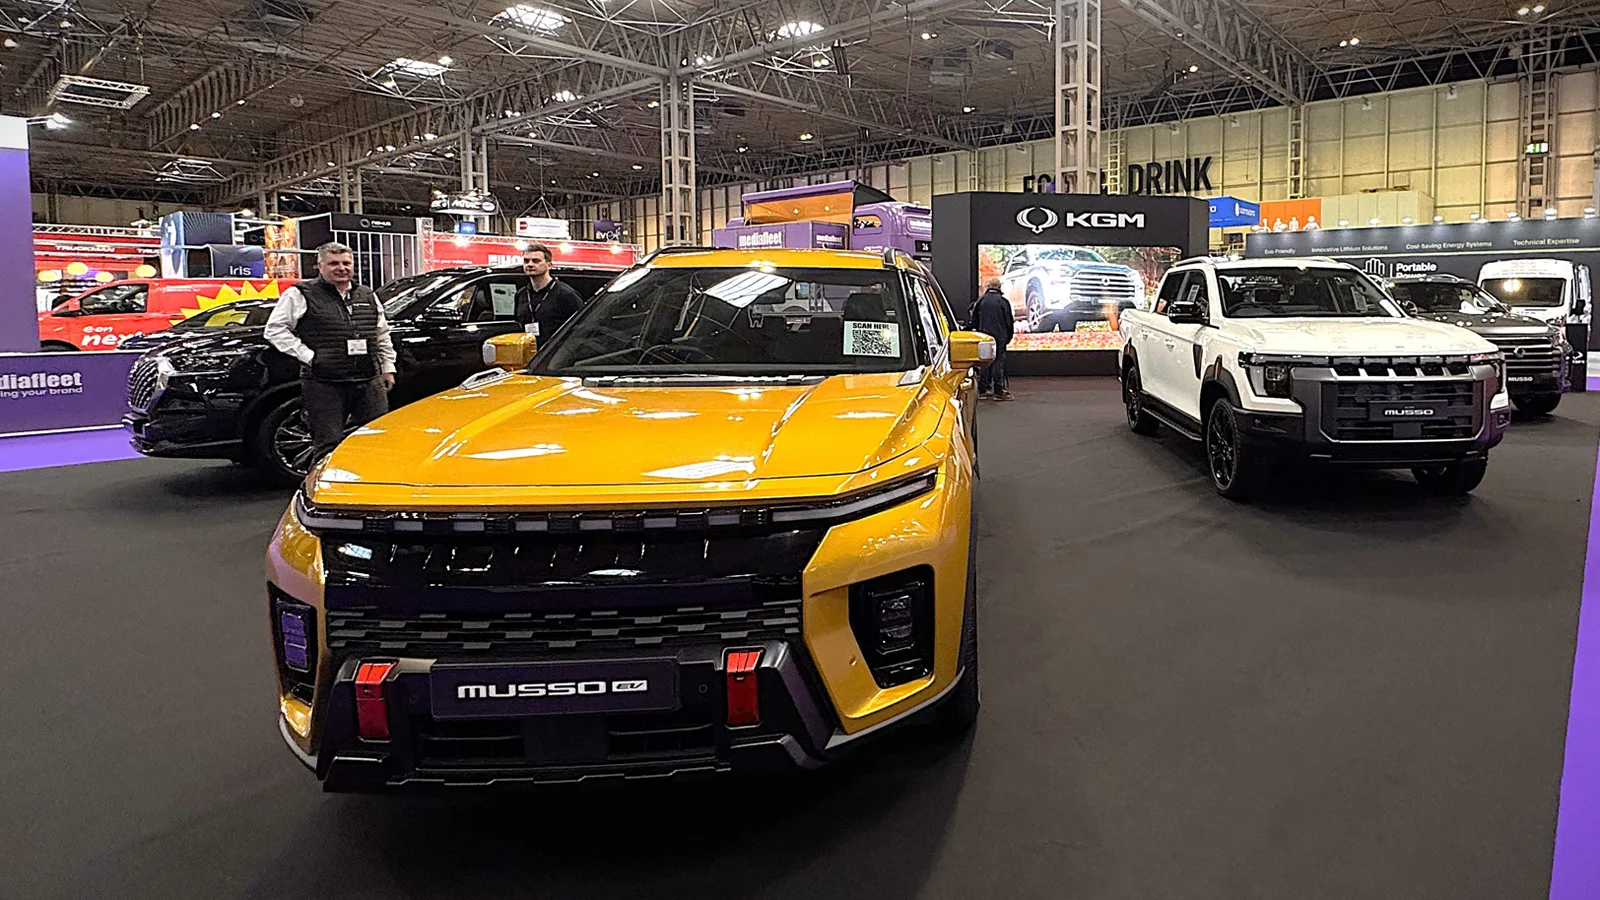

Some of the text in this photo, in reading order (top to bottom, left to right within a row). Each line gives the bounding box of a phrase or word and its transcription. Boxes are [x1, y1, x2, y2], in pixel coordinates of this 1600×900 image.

[1128, 156, 1213, 196] DRINK
[1066, 212, 1145, 228] KGM
[739, 231, 783, 247] mediafleet
[1442, 241, 1465, 249] Energy
[1465, 240, 1493, 249] Systems
[1512, 238, 1580, 246] Technical Expertise
[1361, 244, 1388, 252] Solutions
[1395, 262, 1437, 272] Portable
[21, 389, 47, 398] your
[49, 387, 83, 395] brand
[457, 681, 607, 699] MUSSO
